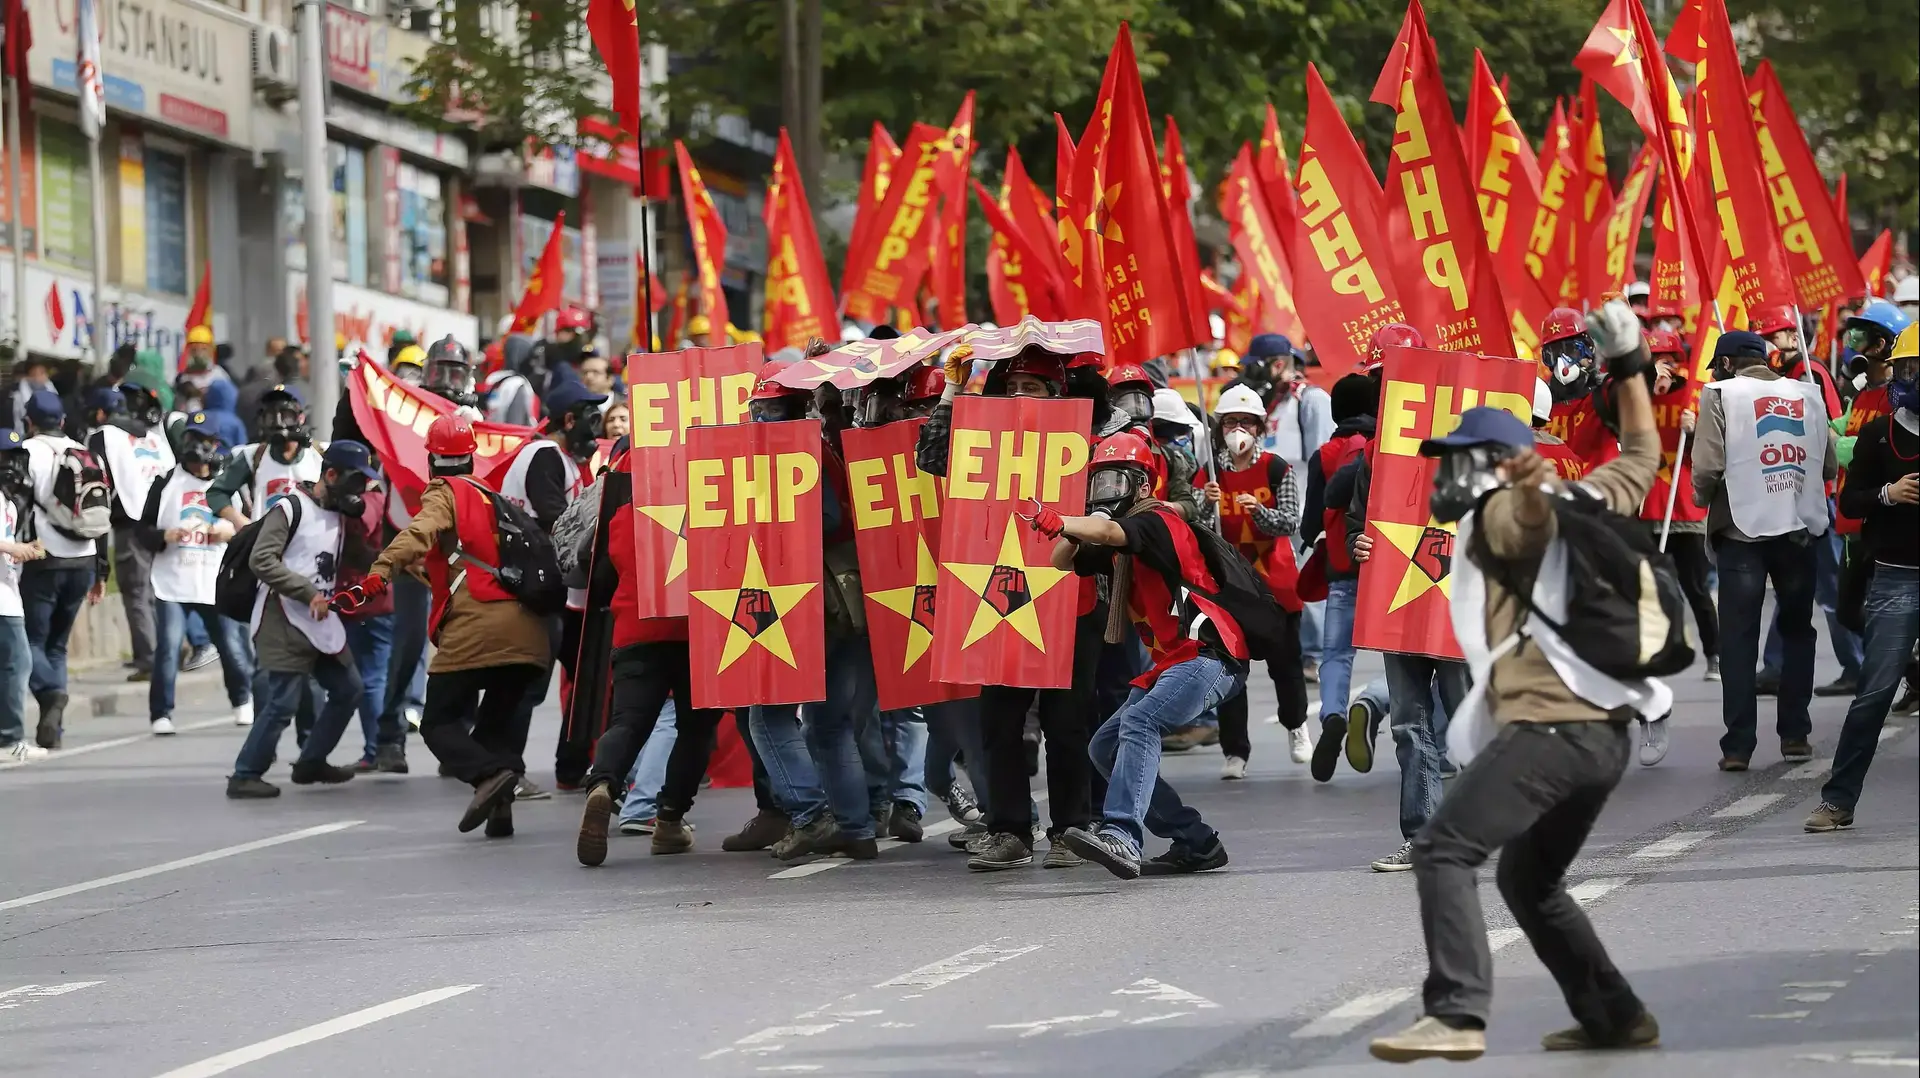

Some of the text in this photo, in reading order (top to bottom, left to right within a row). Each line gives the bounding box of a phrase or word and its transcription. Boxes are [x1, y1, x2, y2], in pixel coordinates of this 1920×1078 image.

[875, 166, 935, 270] EHP
[1477, 131, 1520, 253] EH
[632, 371, 757, 448] EHP
[688, 451, 819, 528] EHP
[848, 452, 947, 530] EH
[949, 428, 1089, 502] EHP
[1760, 443, 1807, 466] ÖDP
